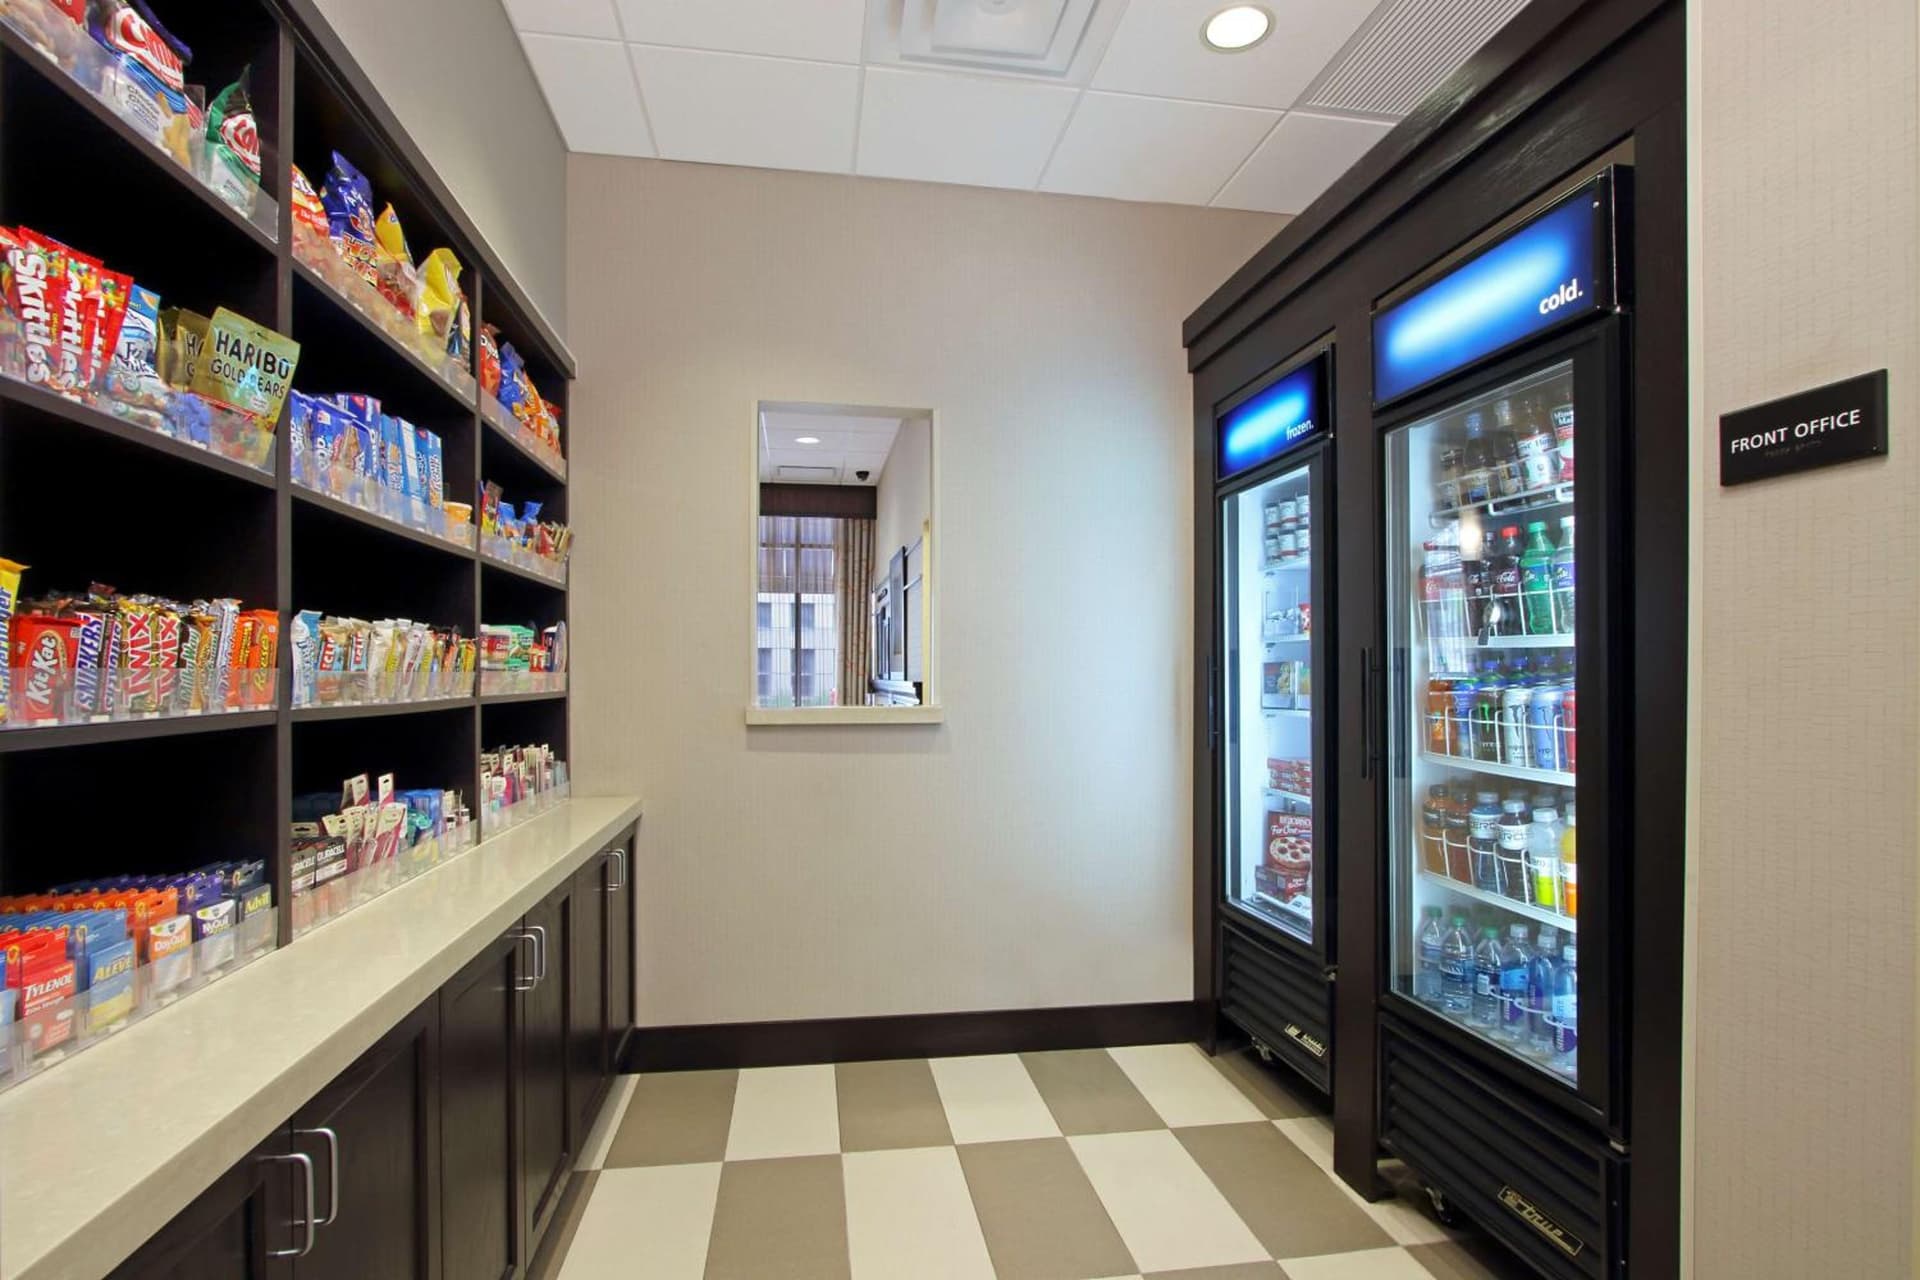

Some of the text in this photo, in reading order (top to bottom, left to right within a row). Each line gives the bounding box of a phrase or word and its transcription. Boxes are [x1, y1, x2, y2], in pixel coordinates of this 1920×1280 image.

[8, 248, 52, 382] Skittles
[1539, 278, 1583, 315] cold.
[215, 329, 291, 380] HARIBO
[1286, 419, 1315, 441] frozen.
[1731, 408, 1862, 455] FRONT OFFICE
[79, 616, 103, 709] SNICKERS
[24, 972, 73, 1002] TYLENOL
[93, 954, 133, 984] ALEVE
